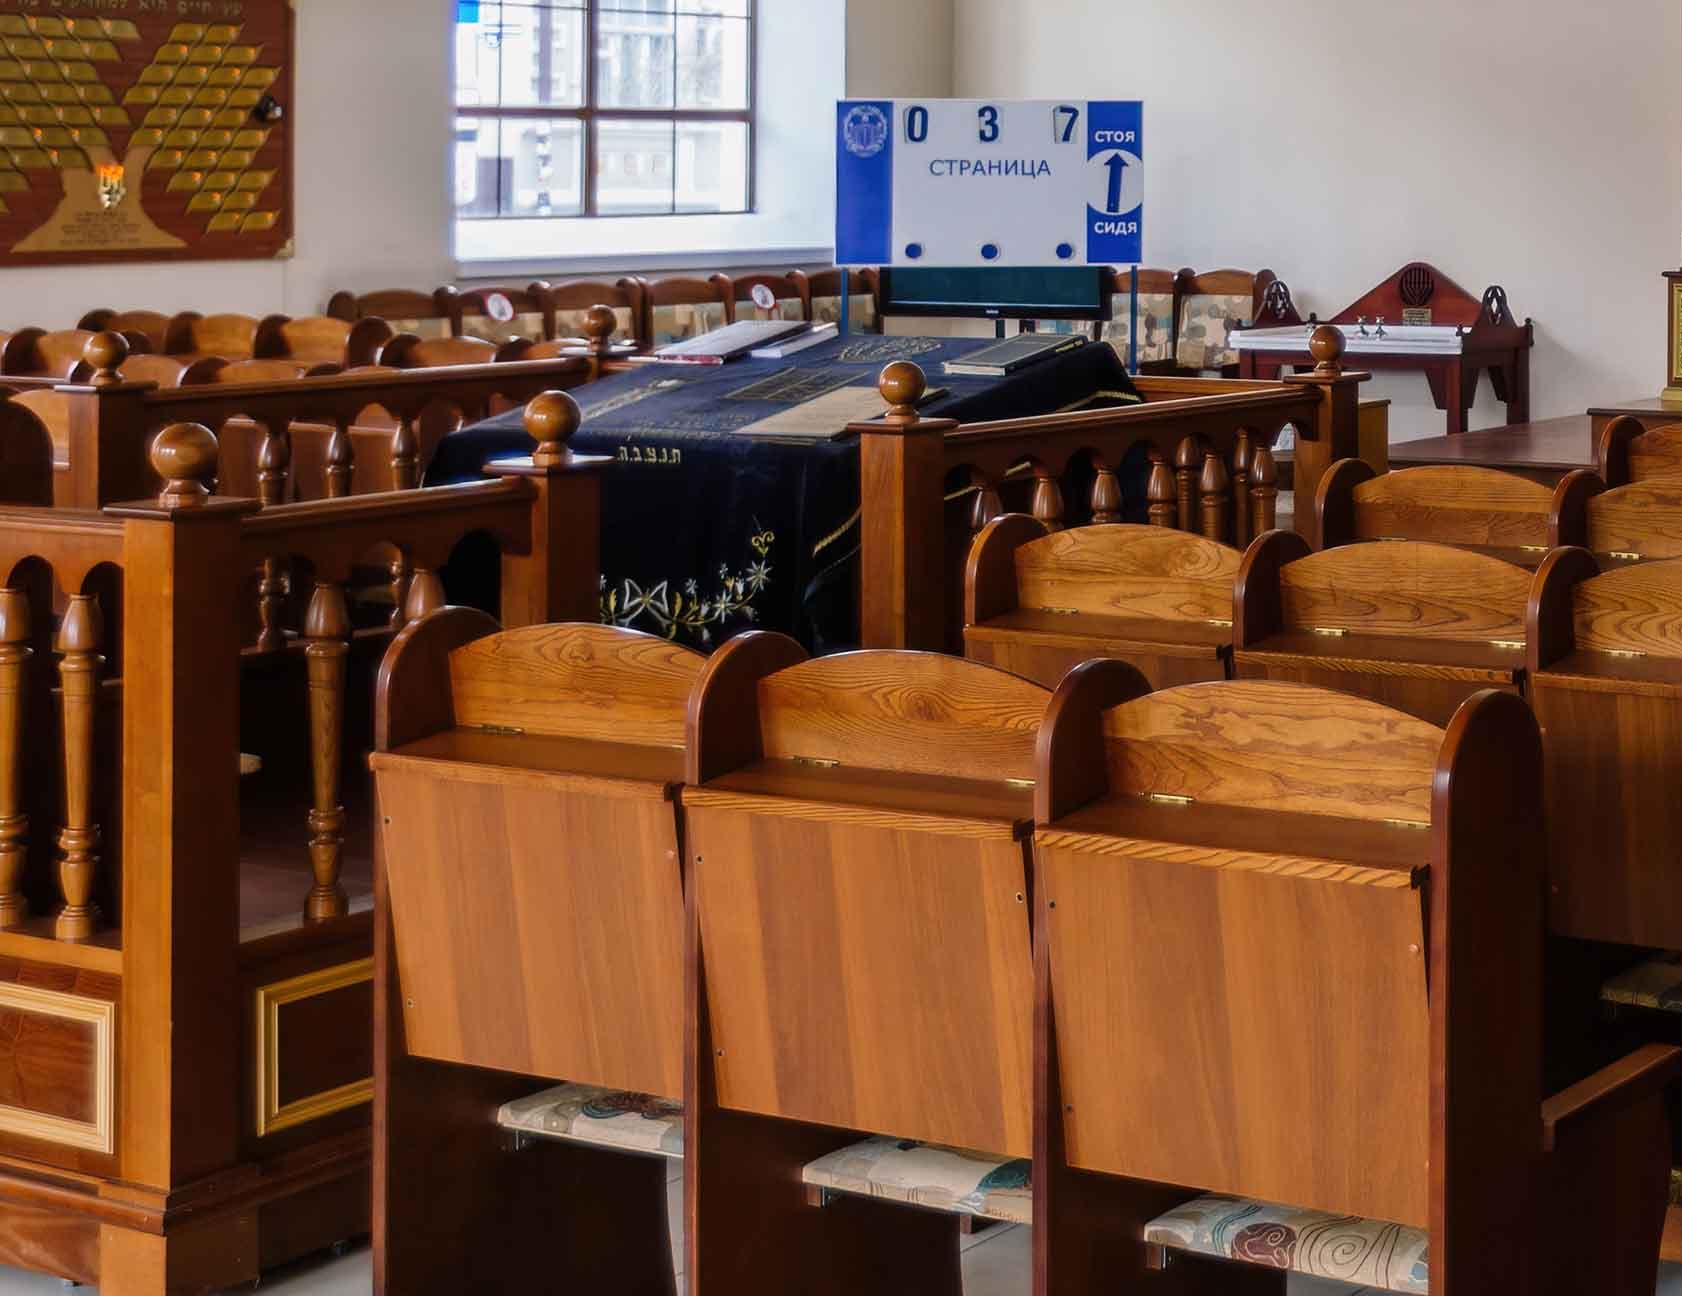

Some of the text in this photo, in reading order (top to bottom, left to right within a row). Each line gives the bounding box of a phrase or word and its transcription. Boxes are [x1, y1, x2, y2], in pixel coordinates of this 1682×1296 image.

[906, 105, 1080, 143] 0 3 7
[1094, 130, 1135, 144] СТОЯ
[929, 159, 1051, 179] СТРАНИЦА
[1094, 221, 1138, 236] СИДЯ
